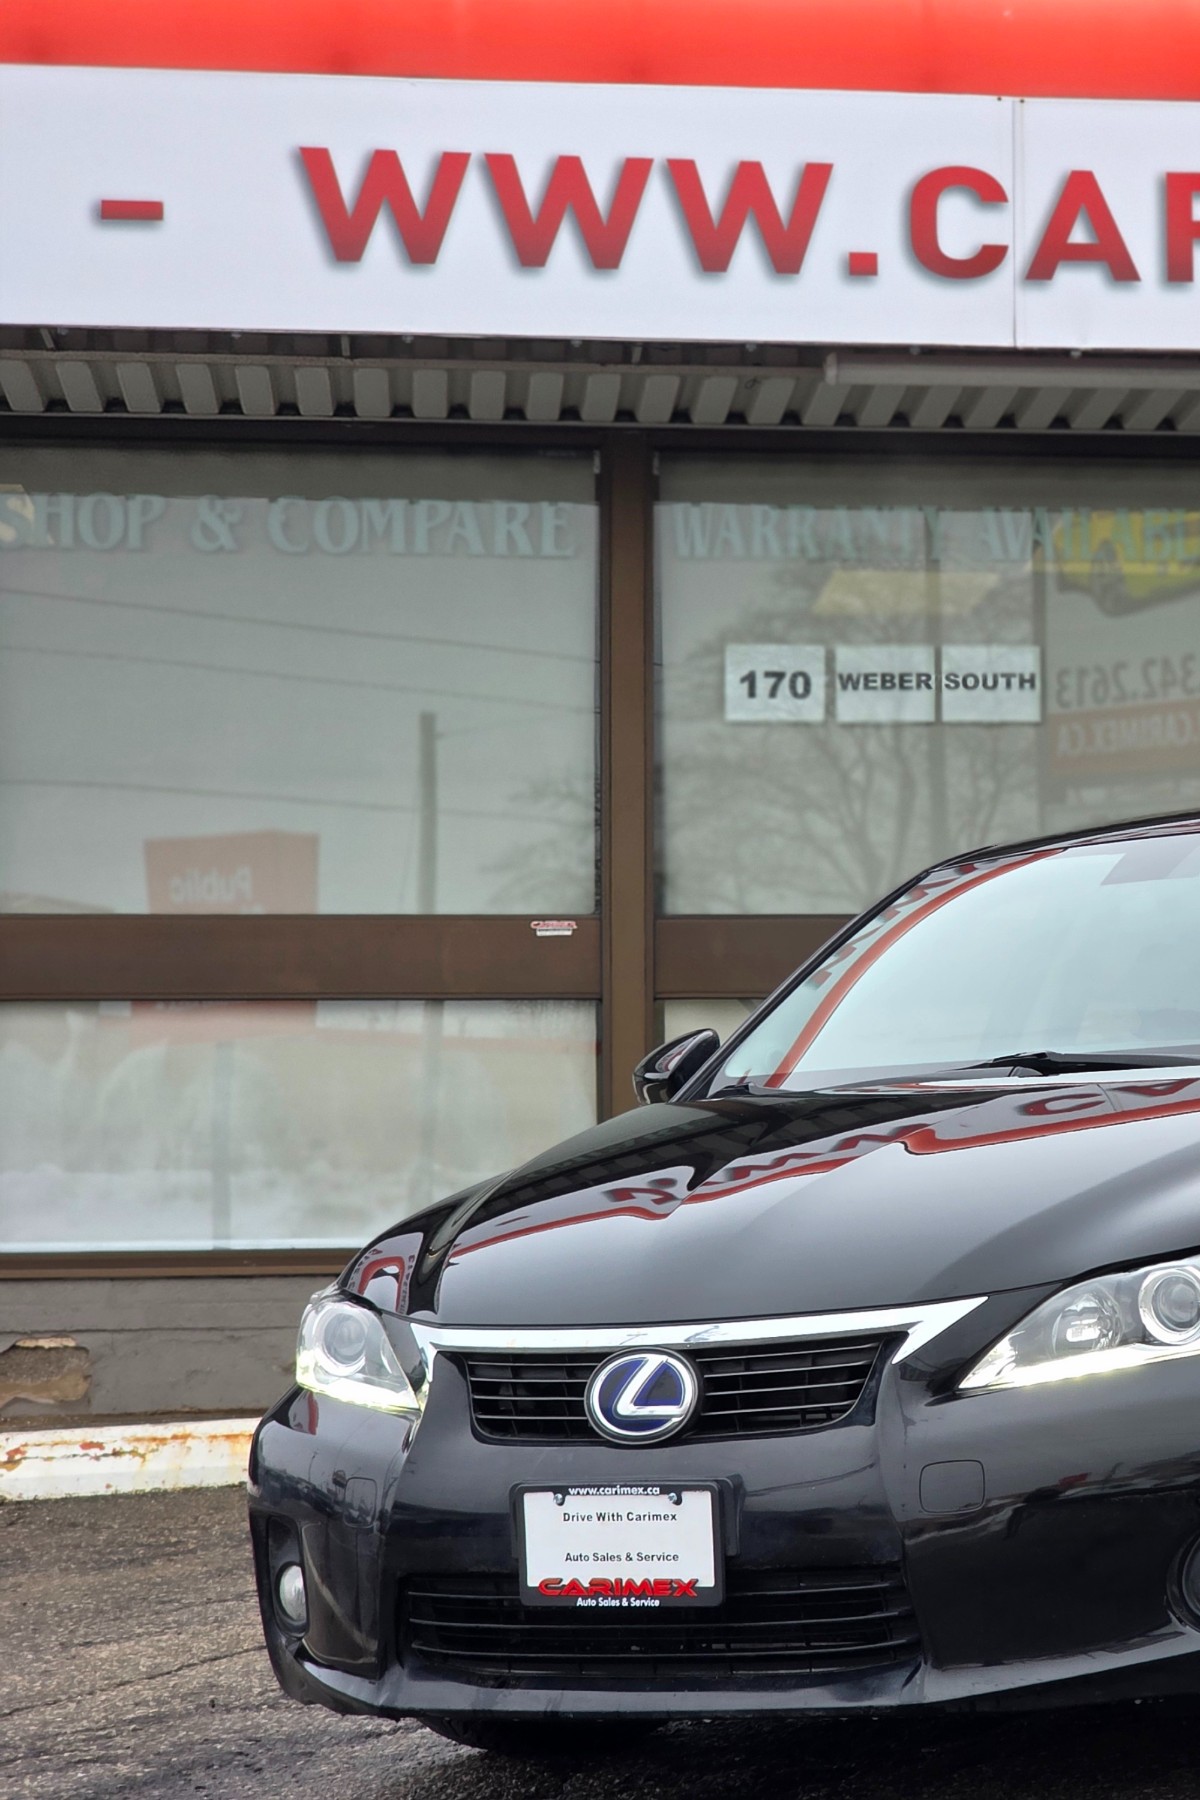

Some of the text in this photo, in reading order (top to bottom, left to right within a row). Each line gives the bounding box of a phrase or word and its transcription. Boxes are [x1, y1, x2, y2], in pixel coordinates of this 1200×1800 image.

[0, 491, 578, 557] SHOP & COMPARE
[672, 503, 945, 560] WARRANTY
[738, 670, 813, 700] 170
[838, 672, 1036, 692] WEBER SOUTH
[568, 1485, 660, 1496] www.carimex.ca
[563, 1511, 677, 1522] Drive With Carimex
[565, 1551, 679, 1562] Auto Sales & Service
[538, 1577, 698, 1597] CARIMEX
[576, 1596, 660, 1608] Auto Sales & Service
